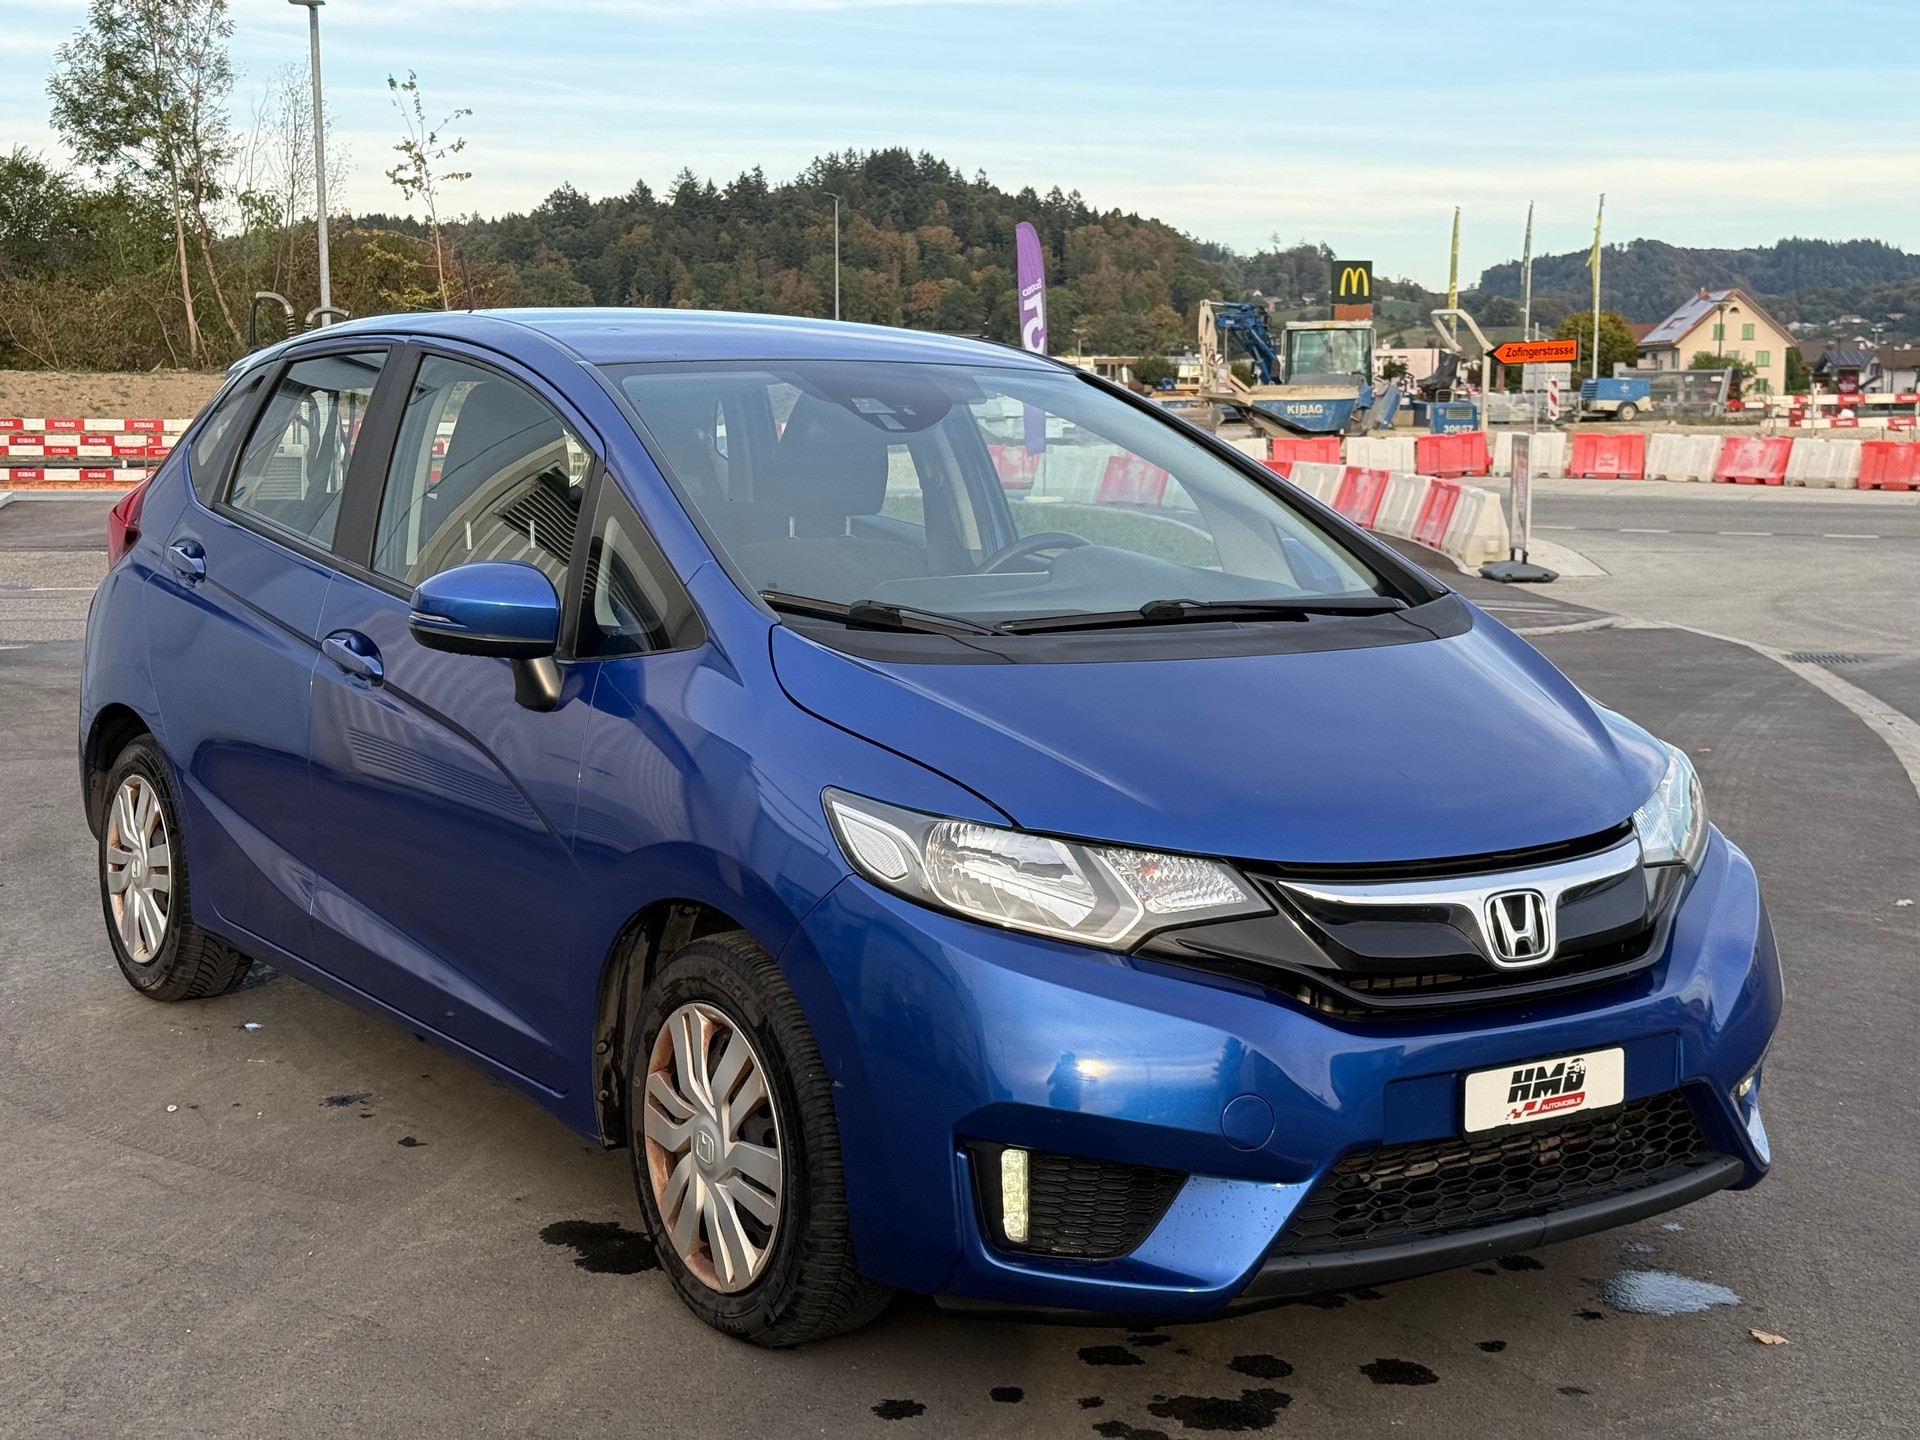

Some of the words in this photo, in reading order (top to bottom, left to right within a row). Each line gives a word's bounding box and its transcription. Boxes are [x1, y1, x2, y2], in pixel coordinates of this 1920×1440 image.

[1505, 346, 1575, 359] Zofingerstrasse
[1286, 404, 1324, 415] KIBAG
[1541, 1097, 1583, 1111] AUTOMOBILE
